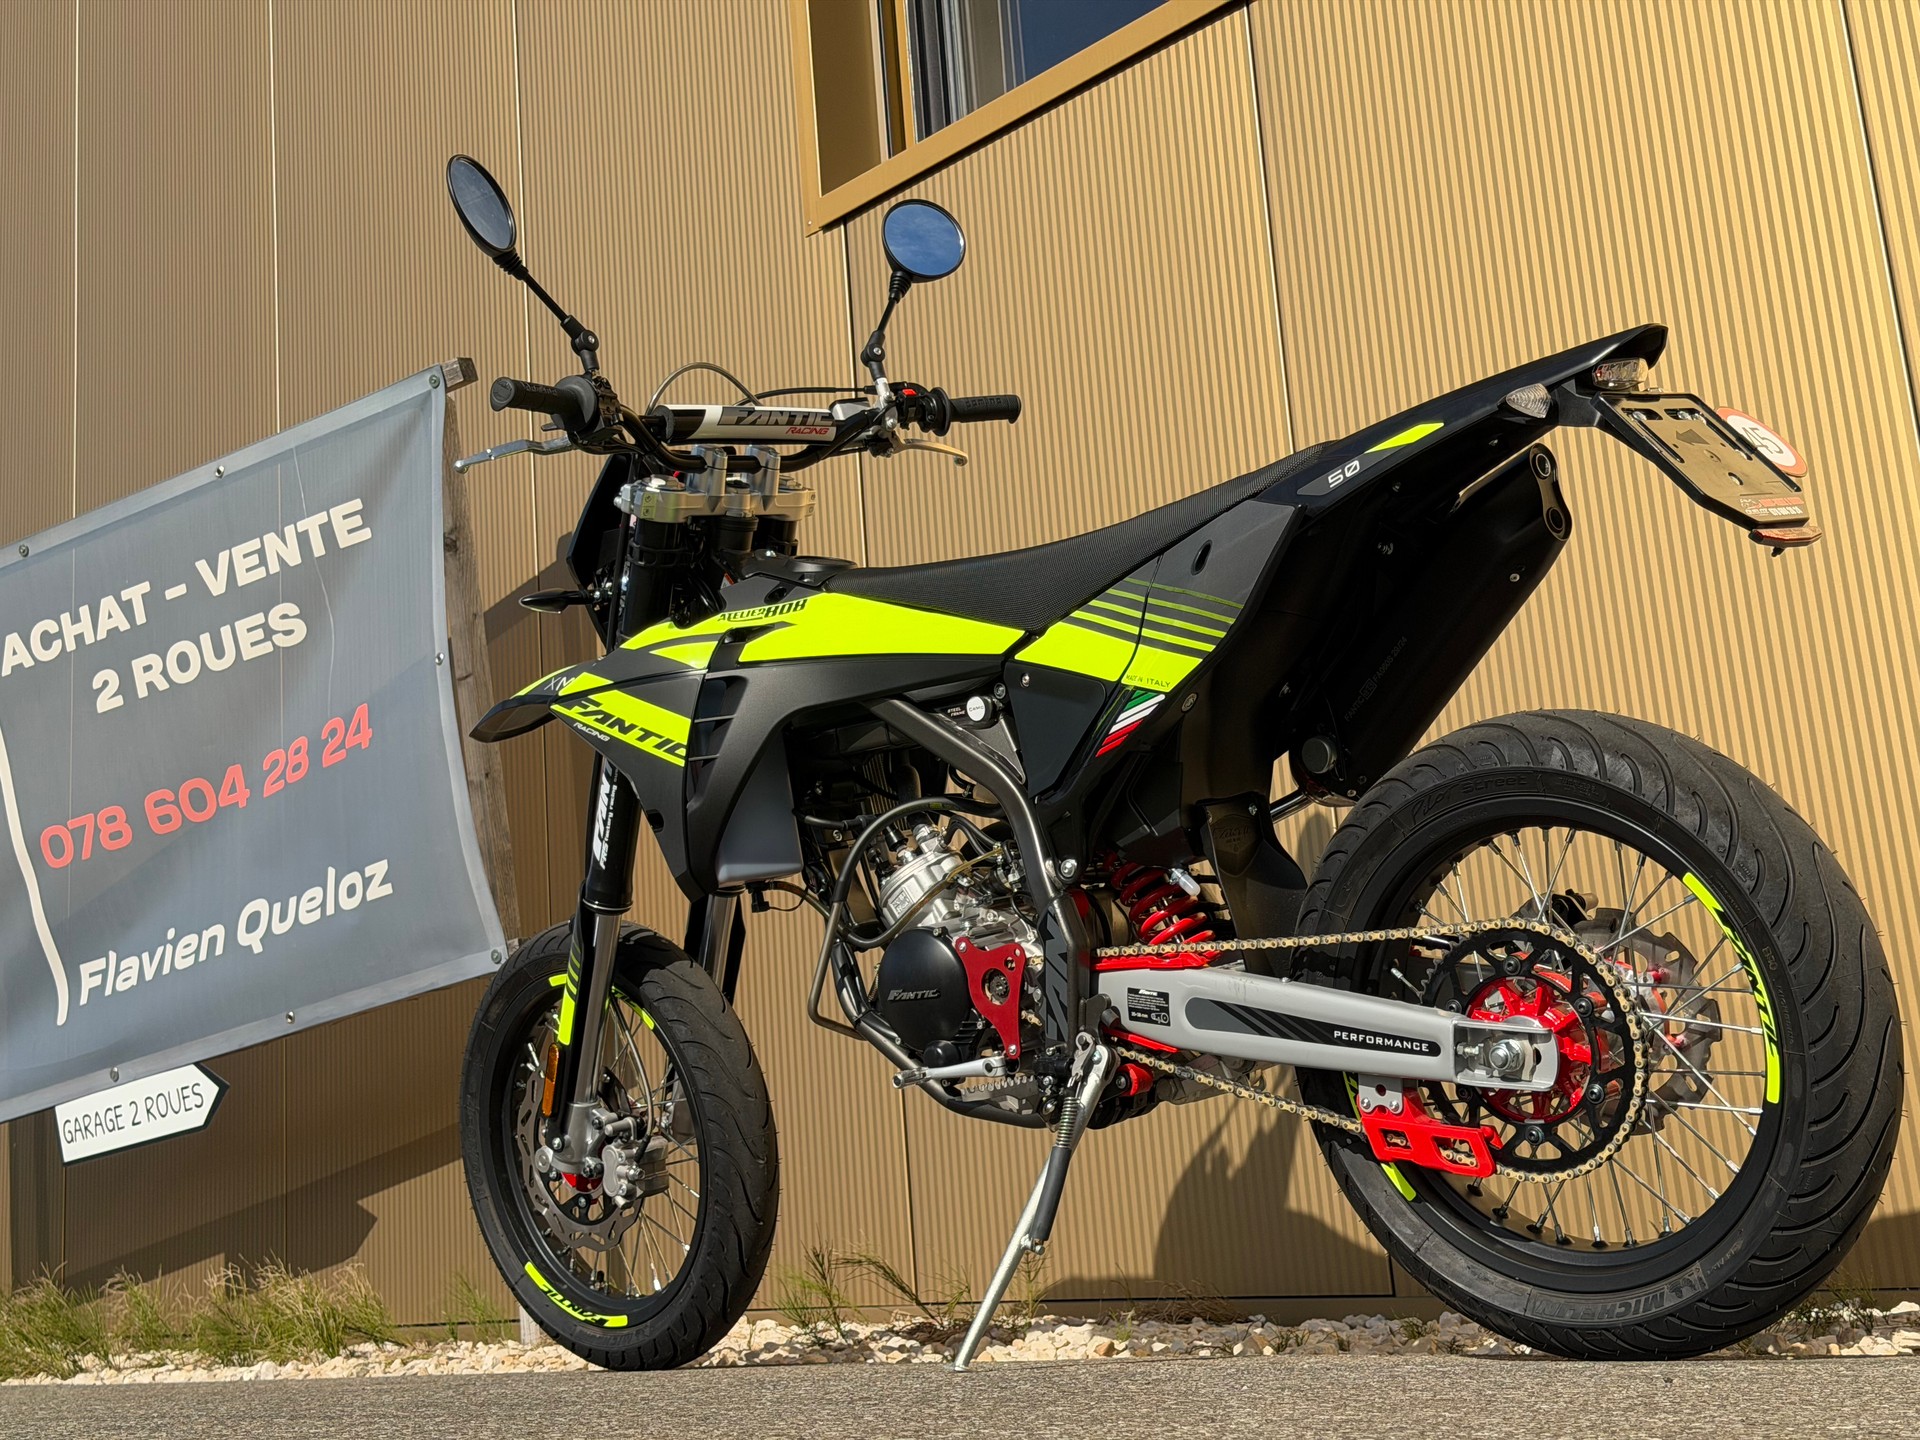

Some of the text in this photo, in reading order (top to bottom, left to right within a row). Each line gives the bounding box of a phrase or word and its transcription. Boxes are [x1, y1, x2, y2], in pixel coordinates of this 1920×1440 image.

[718, 406, 834, 426] FANTIC
[786, 426, 829, 435] RACING
[1742, 427, 1784, 454] 45
[1328, 460, 1360, 488] 50
[1, 581, 151, 678] ACHAT
[194, 498, 372, 597] VENTE
[92, 602, 307, 713] 2 ROUES
[1146, 678, 1171, 688] ITALY
[560, 699, 686, 757] FANTIC
[573, 722, 611, 742] RACING
[40, 703, 373, 868] 078 604 28 24
[1462, 775, 1528, 794] Street
[79, 859, 393, 1006] Flavien Queloz
[887, 989, 941, 1001] FANTIC
[1333, 1030, 1430, 1052] PERFORMANCE
[62, 1082, 204, 1144] GARAGE 2 ROUES
[1533, 1291, 1665, 1320] MICHELIN
